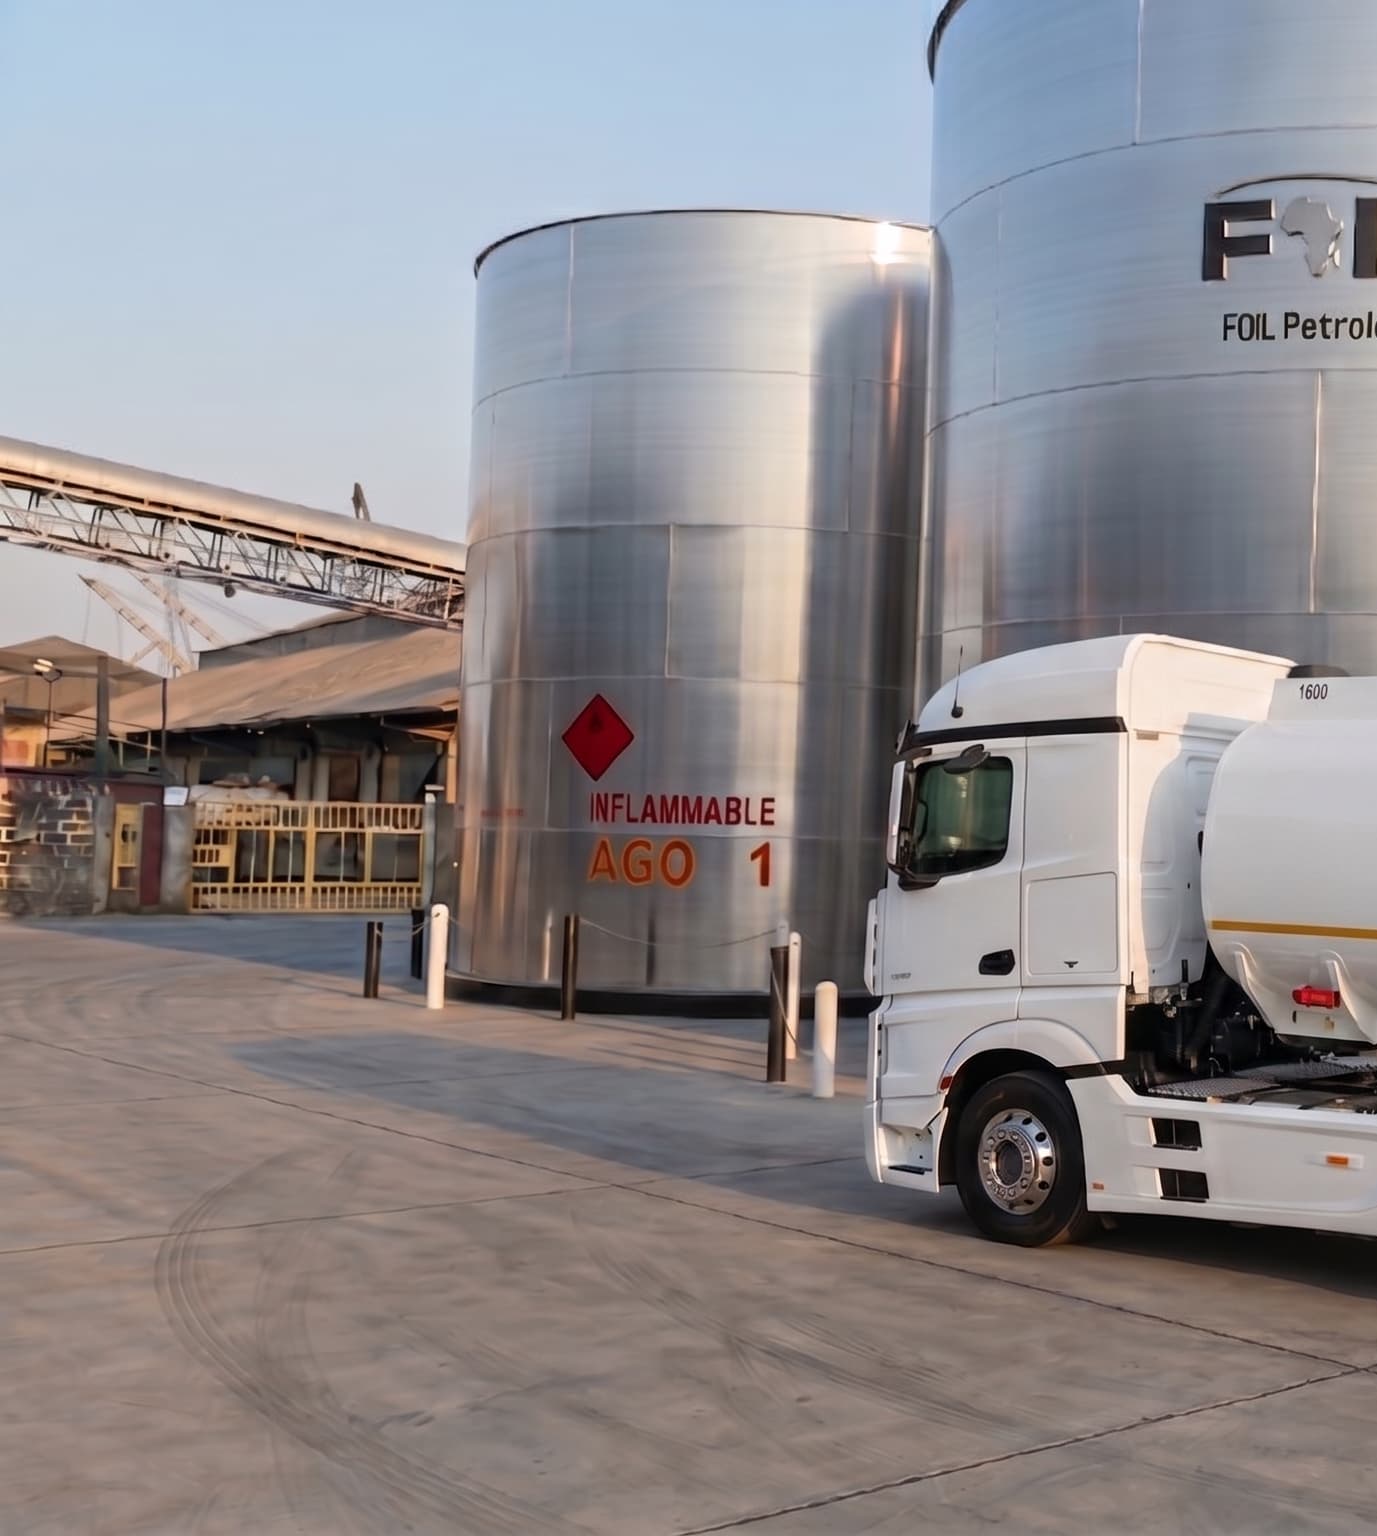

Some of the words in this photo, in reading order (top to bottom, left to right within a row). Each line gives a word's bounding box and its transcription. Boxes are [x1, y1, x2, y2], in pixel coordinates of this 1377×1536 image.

[1223, 312, 1276, 341] FOIL
[1298, 683, 1329, 701] 1600
[590, 791, 776, 826] INFLAMMABLE
[589, 838, 695, 888] AGO
[750, 841, 773, 888] 1
